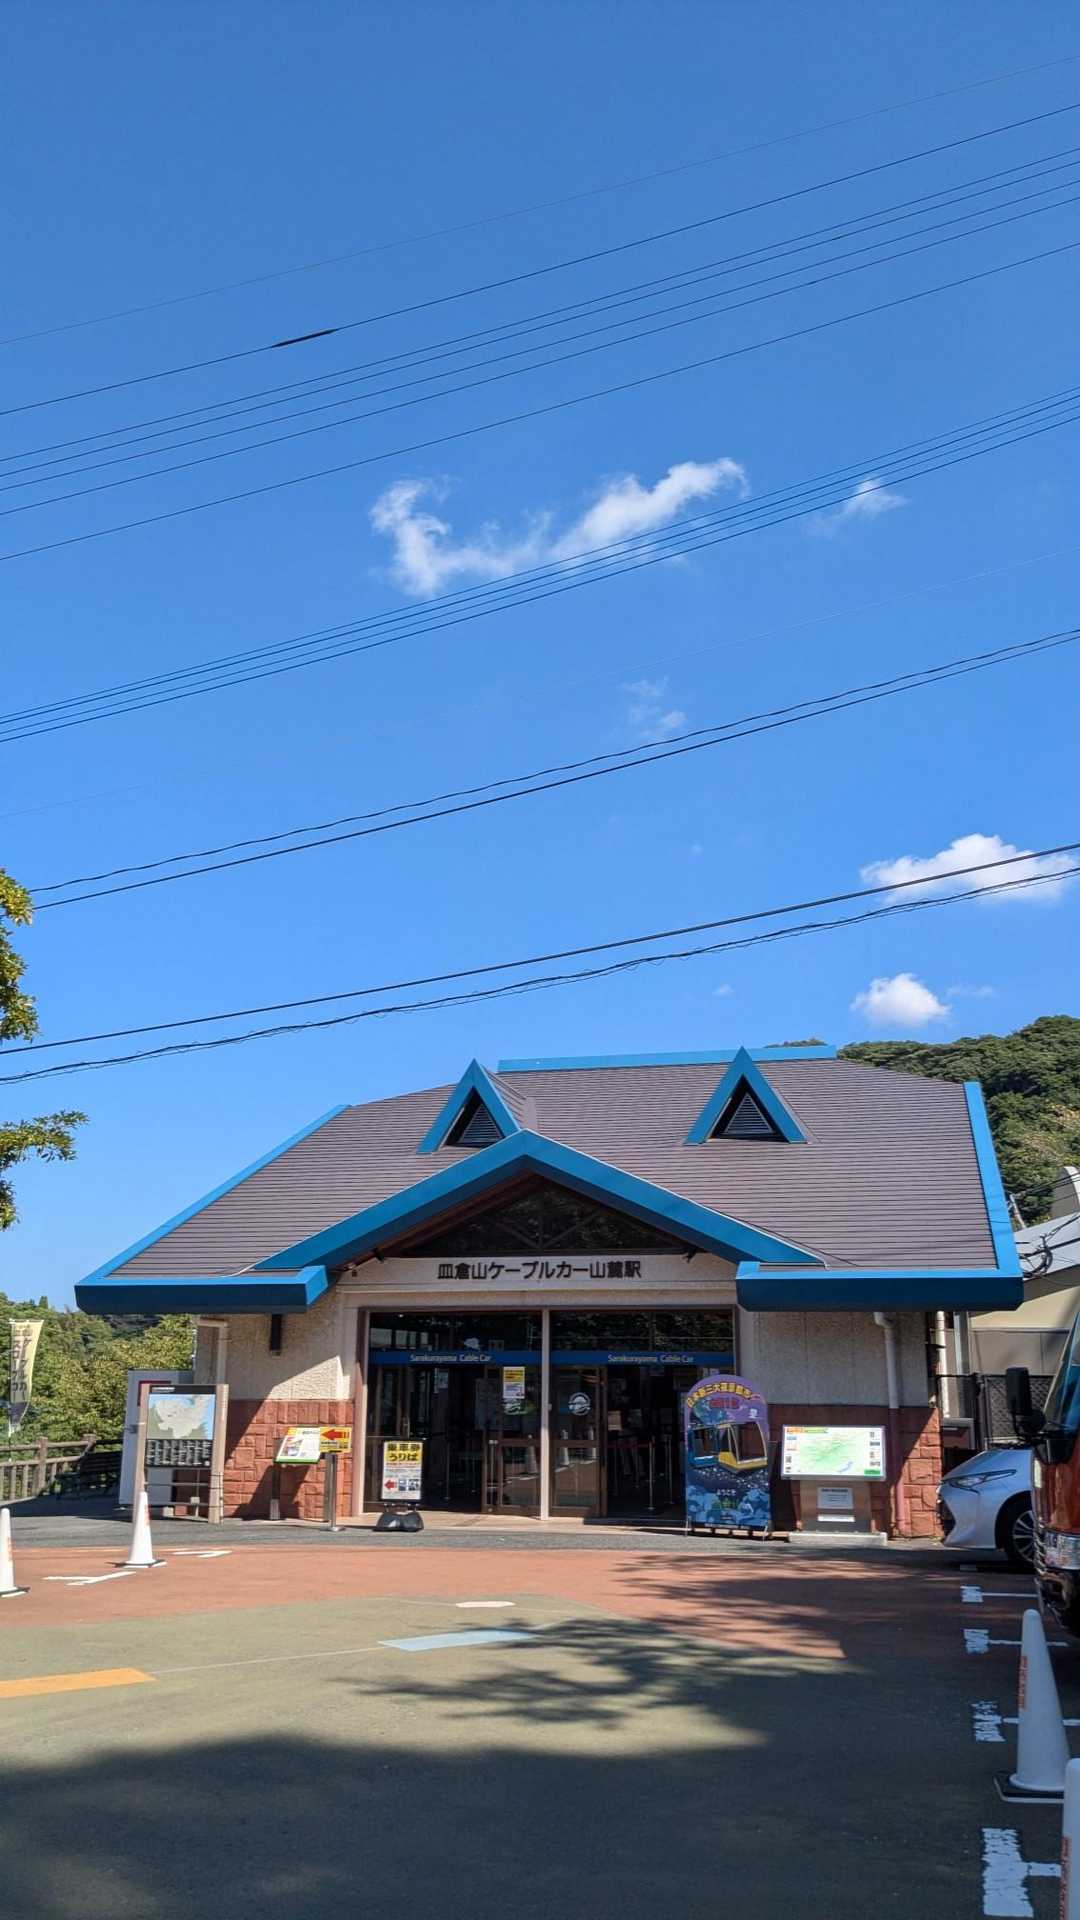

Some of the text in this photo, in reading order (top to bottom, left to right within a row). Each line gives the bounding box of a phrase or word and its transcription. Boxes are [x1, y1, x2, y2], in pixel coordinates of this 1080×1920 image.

[437, 1260, 642, 1280] 皿倉山ケーブルカー山麓駅
[410, 1353, 492, 1364] Sarakurayama Cable Car
[608, 1353, 694, 1364] Sarakurayama Cable Car
[388, 1452, 419, 1461] うりば
